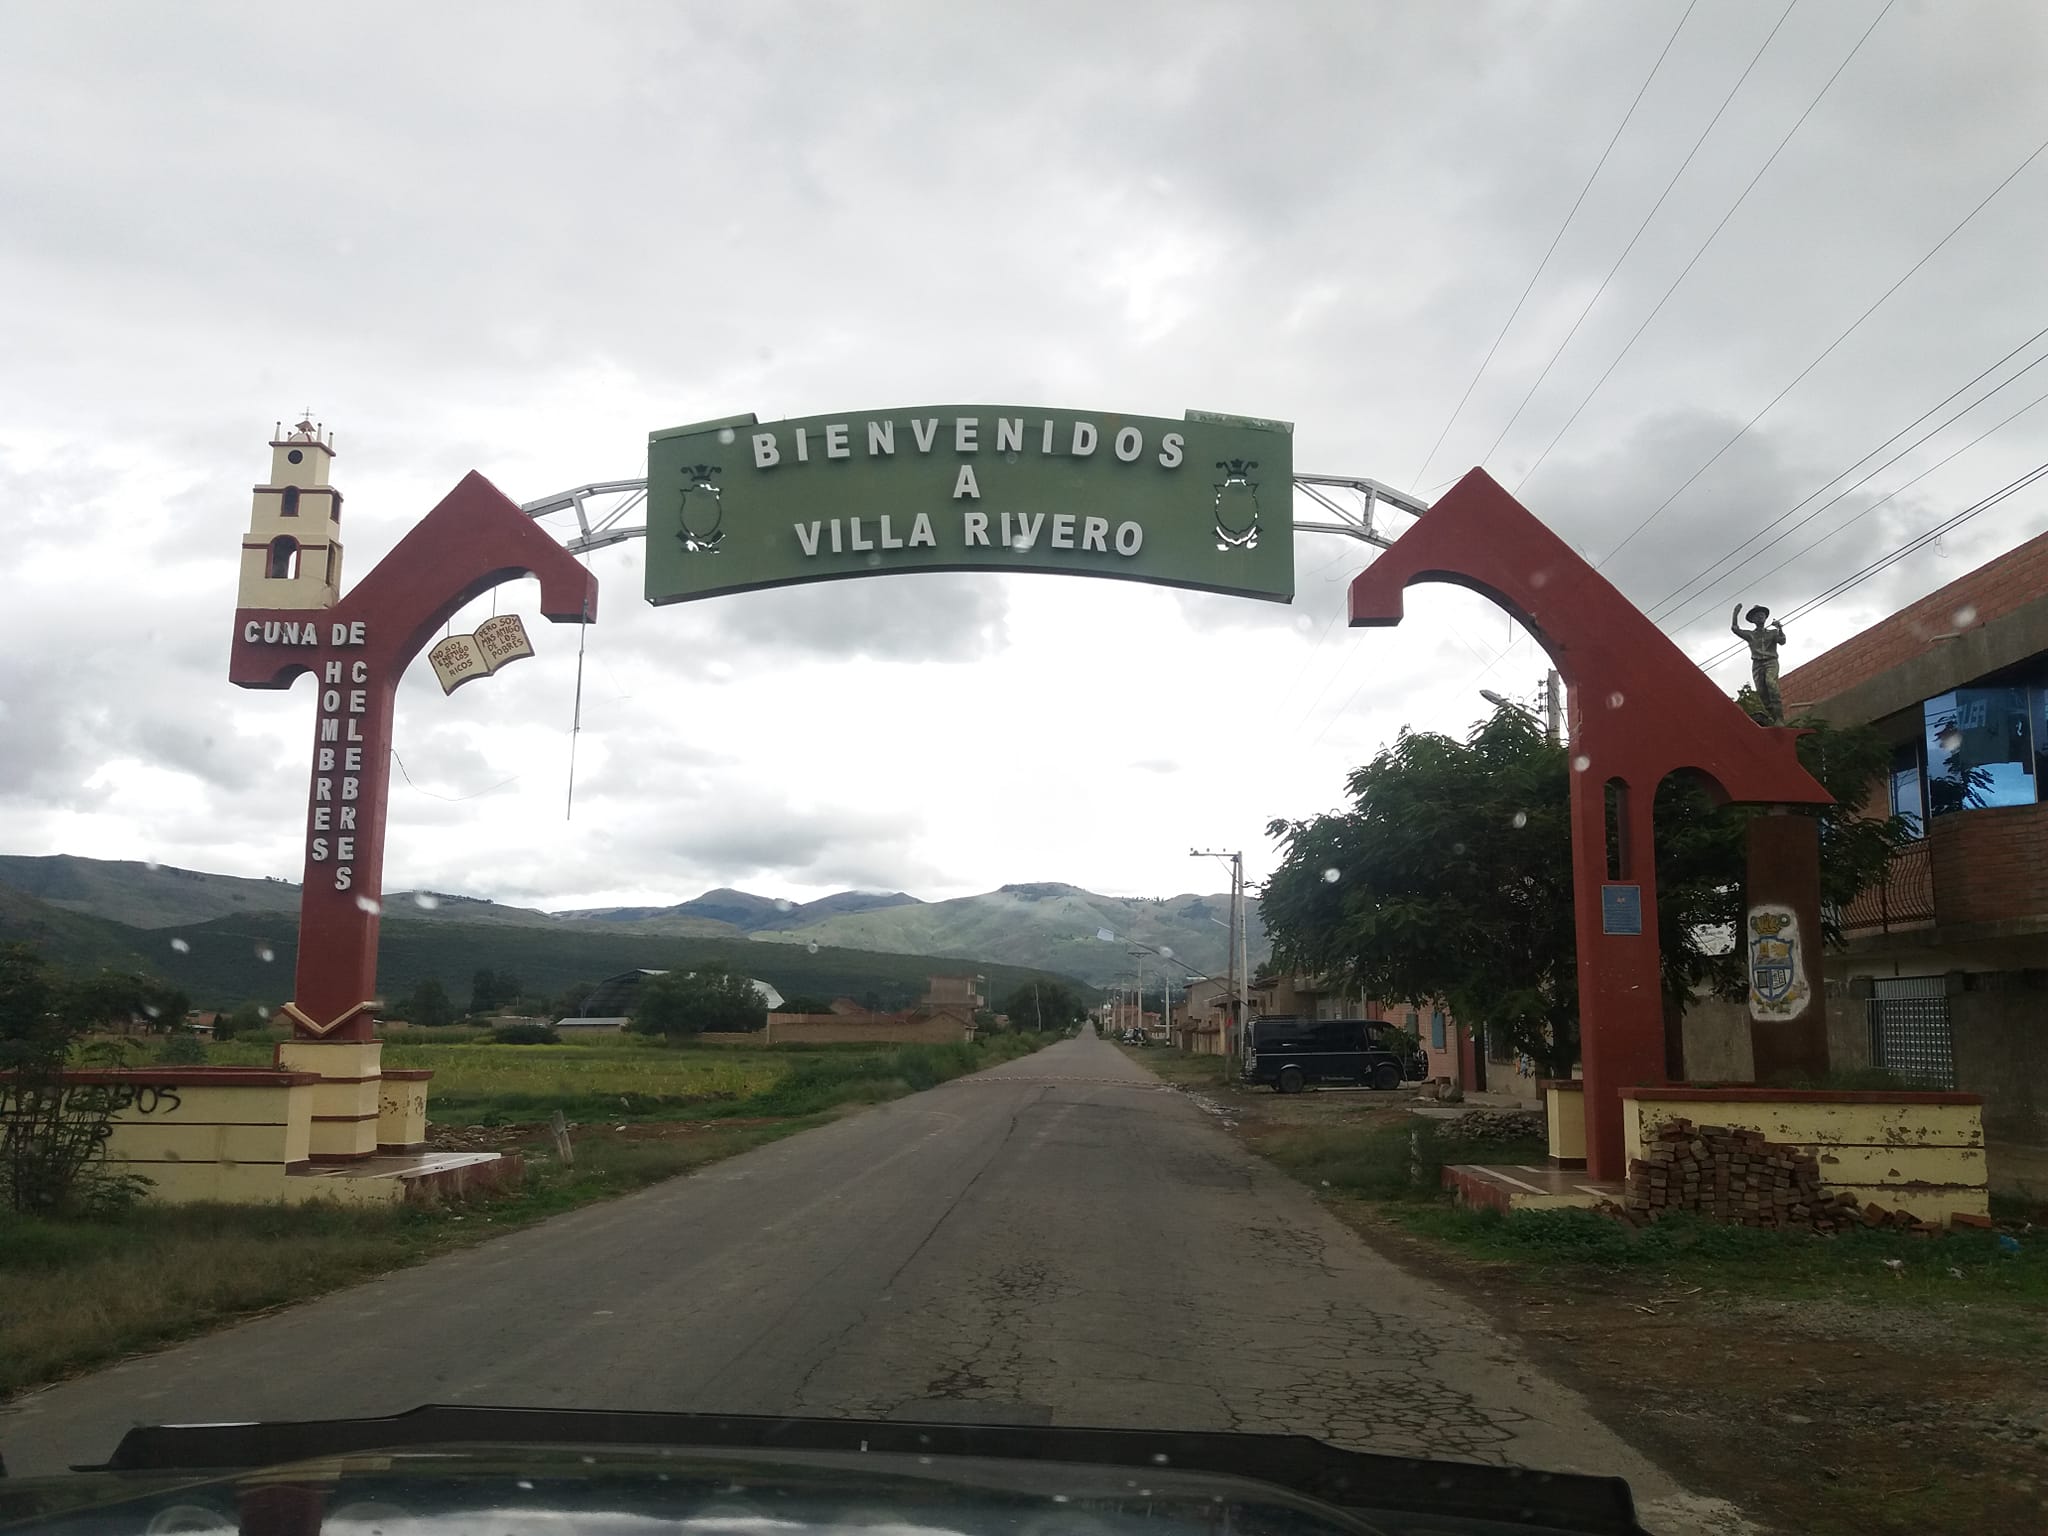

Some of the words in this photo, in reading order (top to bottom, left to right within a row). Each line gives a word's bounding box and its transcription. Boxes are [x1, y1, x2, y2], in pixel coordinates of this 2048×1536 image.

[752, 417, 1185, 469] BIENVENIDOS
[952, 464, 981, 499] A
[794, 512, 938, 556] VILLA
[964, 510, 1144, 557] RIVERO
[244, 621, 318, 646] CUNA
[331, 621, 366, 646] DE
[478, 623, 497, 638] PERO
[499, 617, 517, 627] SOY
[481, 633, 496, 648] MAS
[496, 624, 520, 638] AMIGO
[432, 650, 444, 661] NO
[445, 641, 460, 654] SOY
[487, 642, 498, 652] DE
[500, 633, 517, 645] LOS
[491, 638, 524, 660] POBRES
[444, 660, 454, 669] DE
[455, 652, 469, 661] LOS
[449, 659, 473, 677] RICOS
[311, 661, 342, 861] HOMBRES
[334, 660, 368, 891] CELEBRES
